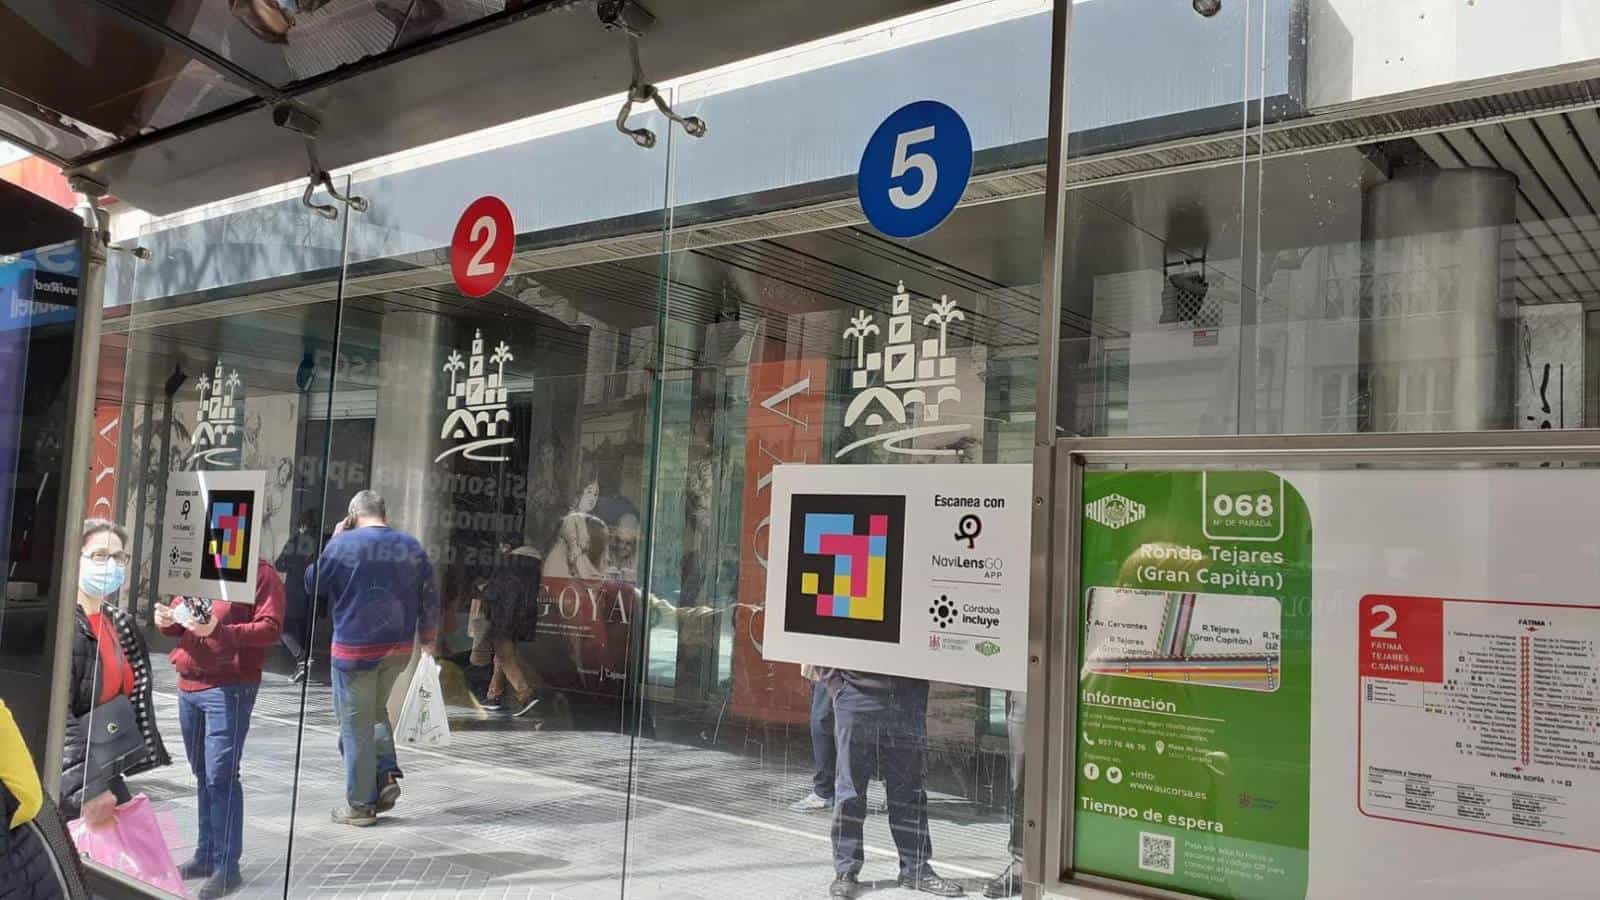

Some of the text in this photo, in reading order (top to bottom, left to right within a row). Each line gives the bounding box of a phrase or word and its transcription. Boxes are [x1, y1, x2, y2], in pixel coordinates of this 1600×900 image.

[888, 125, 938, 210] 5
[466, 215, 497, 277] 2
[934, 494, 1005, 508] Escanea con
[1213, 494, 1274, 517] 068
[931, 554, 1003, 570] NaviLensGO
[1140, 543, 1284, 566] Ronda Tejares
[1136, 565, 1283, 589] (Gran Capitán)
[962, 613, 1000, 629] incluye
[1107, 620, 1148, 630] Cervantes
[1370, 604, 1398, 639] 2
[1081, 688, 1177, 713] Información
[1129, 781, 1207, 800] www.aucorsa.es
[1080, 796, 1224, 833] Tiempo de espera
